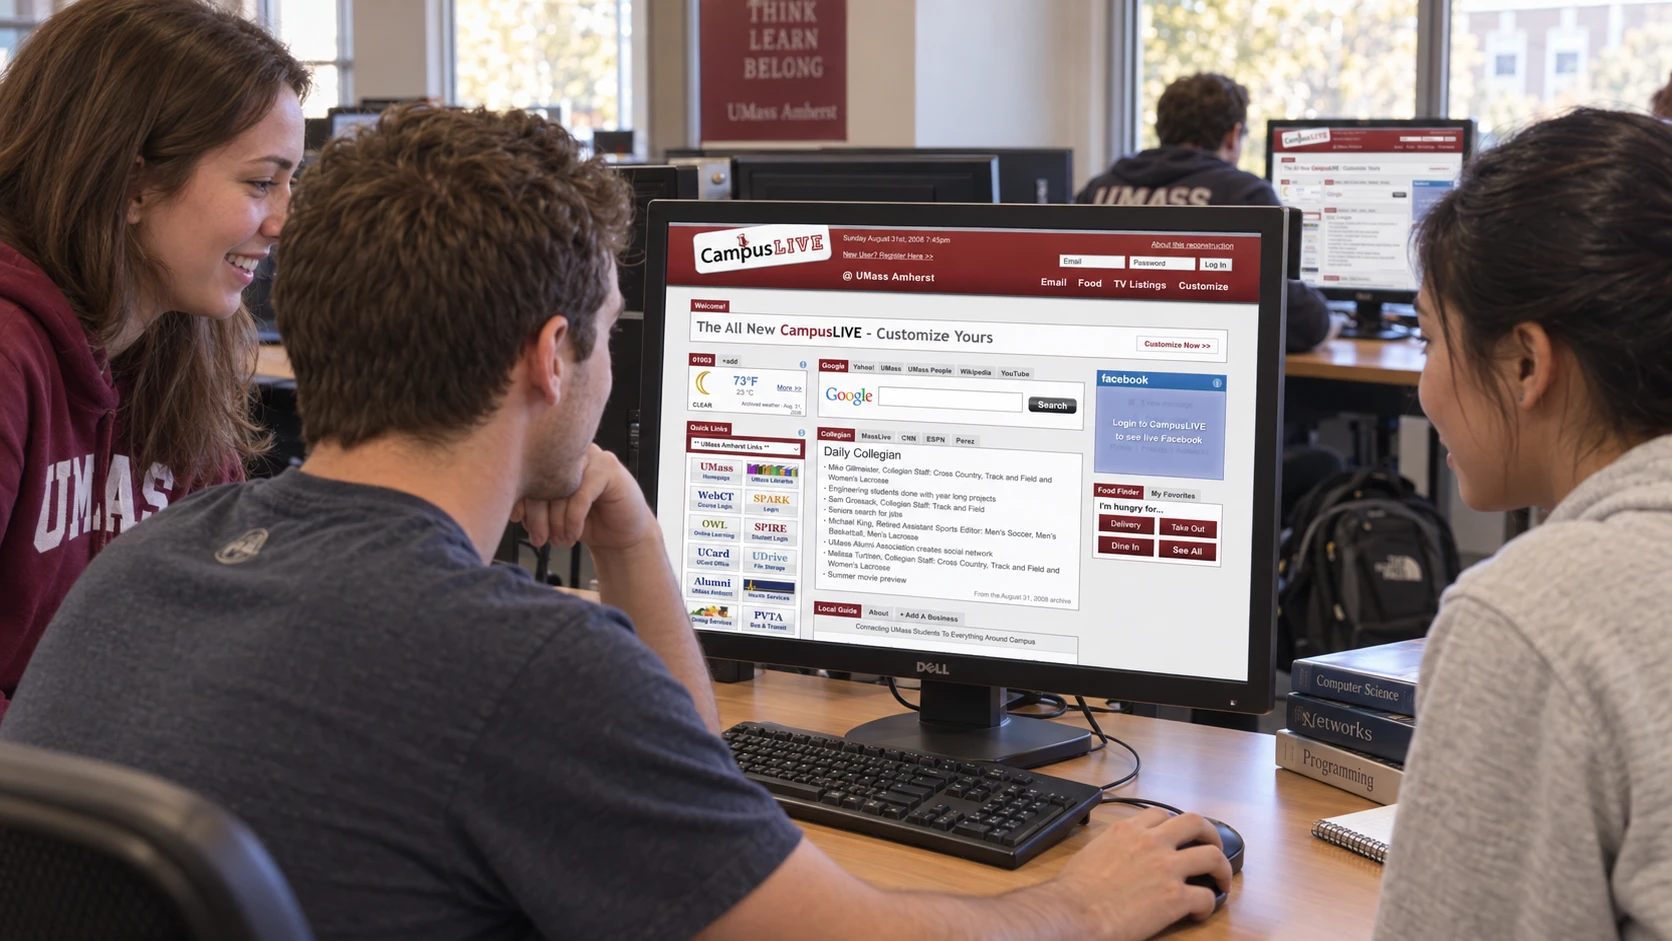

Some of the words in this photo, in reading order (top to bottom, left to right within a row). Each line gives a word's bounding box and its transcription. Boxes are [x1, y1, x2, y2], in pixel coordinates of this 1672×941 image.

[747, 1, 817, 23] THINK
[750, 28, 819, 50] LEARN
[744, 56, 823, 79] BELONG
[727, 102, 778, 121] UMass
[781, 102, 837, 121] Amherst
[1093, 186, 1212, 205] UMASS
[843, 235, 866, 243] Sunday
[700, 233, 824, 263] CampusLIVE
[1151, 241, 1171, 249] About
[1187, 242, 1234, 250] reconstruction
[880, 252, 906, 260] Register
[1205, 261, 1218, 269] Log
[843, 271, 853, 281] @
[856, 272, 889, 281] UMass
[892, 273, 935, 282] Amherst
[1041, 278, 1067, 287] Email
[1078, 279, 1102, 288] Food
[1114, 280, 1126, 288] TV
[1130, 281, 1167, 291] Listings
[1179, 282, 1229, 291] Customize
[697, 321, 721, 333] The
[725, 322, 742, 334] All
[747, 324, 775, 335] New
[780, 324, 862, 339] CampusLIVE
[876, 328, 950, 342] Customize
[954, 330, 993, 344] Yours
[1144, 340, 1183, 349] Customize
[1184, 342, 1200, 350] Now
[734, 376, 759, 386] 73°F
[1102, 374, 1149, 384] facebook
[826, 387, 873, 406] Google
[1038, 401, 1067, 410] Search
[1112, 419, 1137, 429] Login
[1139, 420, 1147, 428] to
[1150, 421, 1206, 431] CampusLIVE
[821, 431, 851, 439] Collegian
[1144, 434, 1159, 442] live
[1161, 435, 1203, 444] Facebook
[824, 446, 850, 459] Daily
[854, 448, 901, 462] Collegian
[700, 462, 734, 472] UMass
[883, 467, 913, 476] Collegian
[955, 471, 983, 480] Country,
[698, 491, 734, 501] WebCT
[828, 485, 869, 495] Engineering
[871, 488, 899, 496] students
[969, 495, 996, 503] projects
[1098, 487, 1116, 495] Food
[1117, 488, 1139, 496] Finder
[34, 454, 174, 553] UMAS
[754, 494, 790, 504] SPARK
[1114, 504, 1143, 513] hungry
[1146, 506, 1164, 514] for...
[702, 520, 728, 529] OWL
[755, 523, 787, 533] SPIRE
[1111, 520, 1141, 530] Delivery
[1172, 524, 1189, 532] Take
[1191, 525, 1205, 533] Out
[1112, 542, 1130, 550] Dine
[1173, 546, 1189, 554] See
[698, 548, 730, 558] UCard
[753, 552, 788, 562] UDrive
[694, 577, 731, 588] Alumni
[828, 572, 855, 580] Summer
[880, 576, 907, 584] preview
[1001, 593, 1022, 601] August
[754, 611, 783, 621] PVTA
[869, 609, 889, 617] About
[856, 623, 889, 633] Connecting
[891, 626, 912, 634] UMass
[913, 628, 940, 637] Students
[951, 632, 984, 641] Everything
[985, 635, 1008, 643] Around
[1009, 636, 1035, 645] Campus
[917, 662, 949, 675] DELL
[1317, 675, 1362, 693] Computer
[1365, 684, 1399, 701] Science
[1302, 712, 1372, 741] Networks
[1303, 749, 1374, 792] Programming
